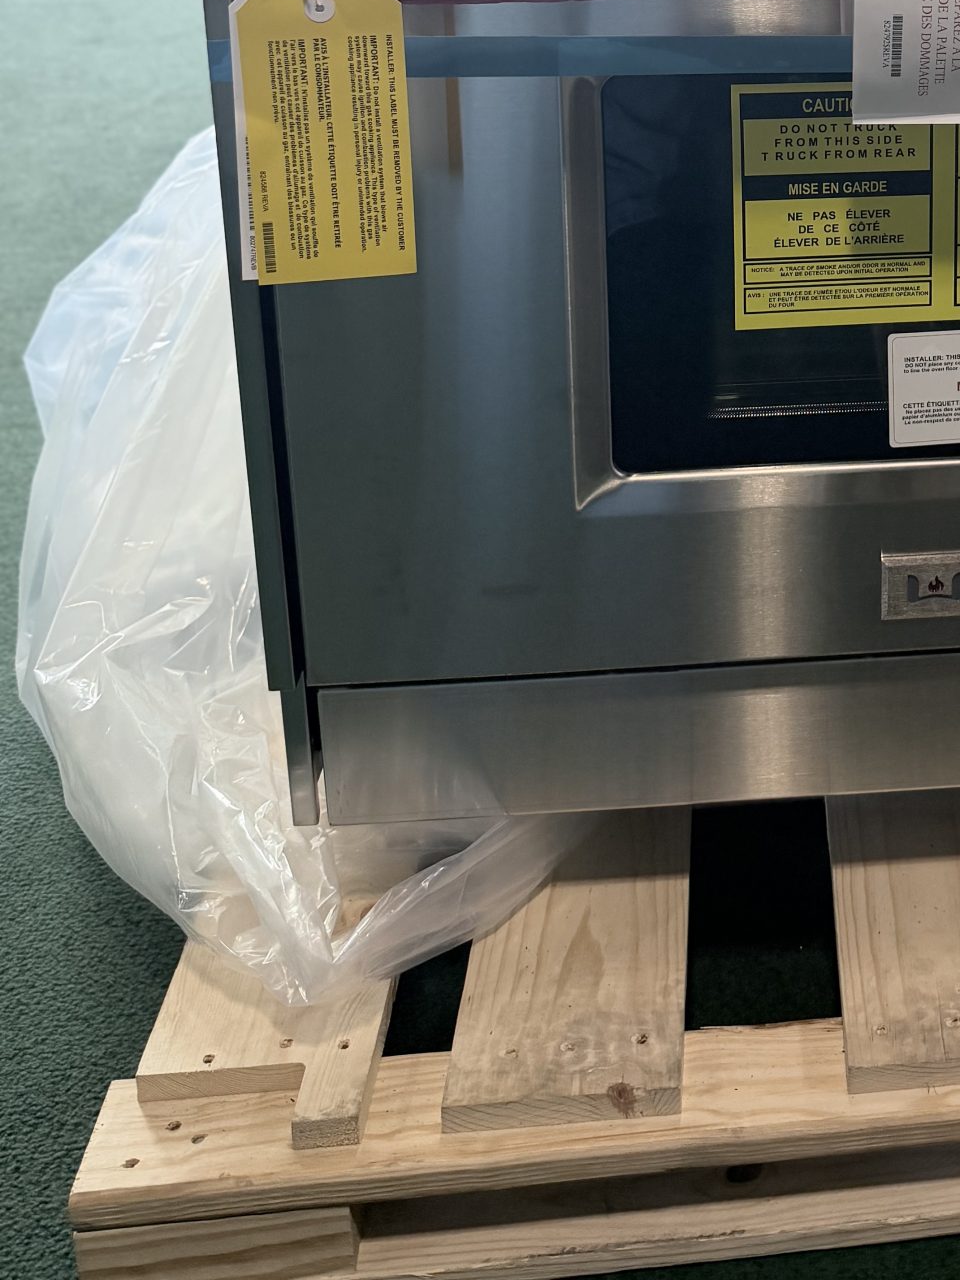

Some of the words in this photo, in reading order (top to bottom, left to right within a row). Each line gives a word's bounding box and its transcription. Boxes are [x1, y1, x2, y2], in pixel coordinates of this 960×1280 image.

[921, 5, 933, 29] DES
[937, 17, 948, 33] LA
[314, 53, 320, 62] LE
[386, 34, 395, 75] INSTALLER:
[934, 37, 948, 84] PALETTE
[918, 33, 932, 96] DOMMAGES
[314, 63, 324, 122] CONSOMMATEUR.
[389, 94, 397, 117] LABEL
[802, 97, 853, 113] CAUTI
[391, 119, 399, 138] MUST
[780, 125, 800, 134] DO
[807, 124, 837, 133] NOT
[844, 123, 897, 132] TRUCK
[392, 139, 400, 149] BE
[775, 137, 818, 148] FROM
[824, 136, 860, 146] THIS
[866, 135, 902, 145] SIDE
[824, 149, 868, 160] FROM
[874, 148, 916, 158] REAR
[393, 150, 402, 185] REMOVED
[395, 186, 402, 195] BY
[788, 183, 819, 195] MISE
[822, 182, 839, 194] EN
[843, 181, 887, 193] GARDE
[787, 212, 803, 222] NE
[813, 211, 836, 221] PAS
[846, 208, 891, 219] ÉLEVER
[397, 212, 405, 251] CUSTOMER
[798, 225, 814, 234] DE
[823, 223, 839, 233] CE
[849, 220, 880, 232] CÔTÉ
[774, 237, 819, 248] ÉLEVER
[826, 237, 841, 246] DE
[844, 233, 904, 245] L'ARRIÈRE
[904, 355, 944, 363] INSTALLER:
